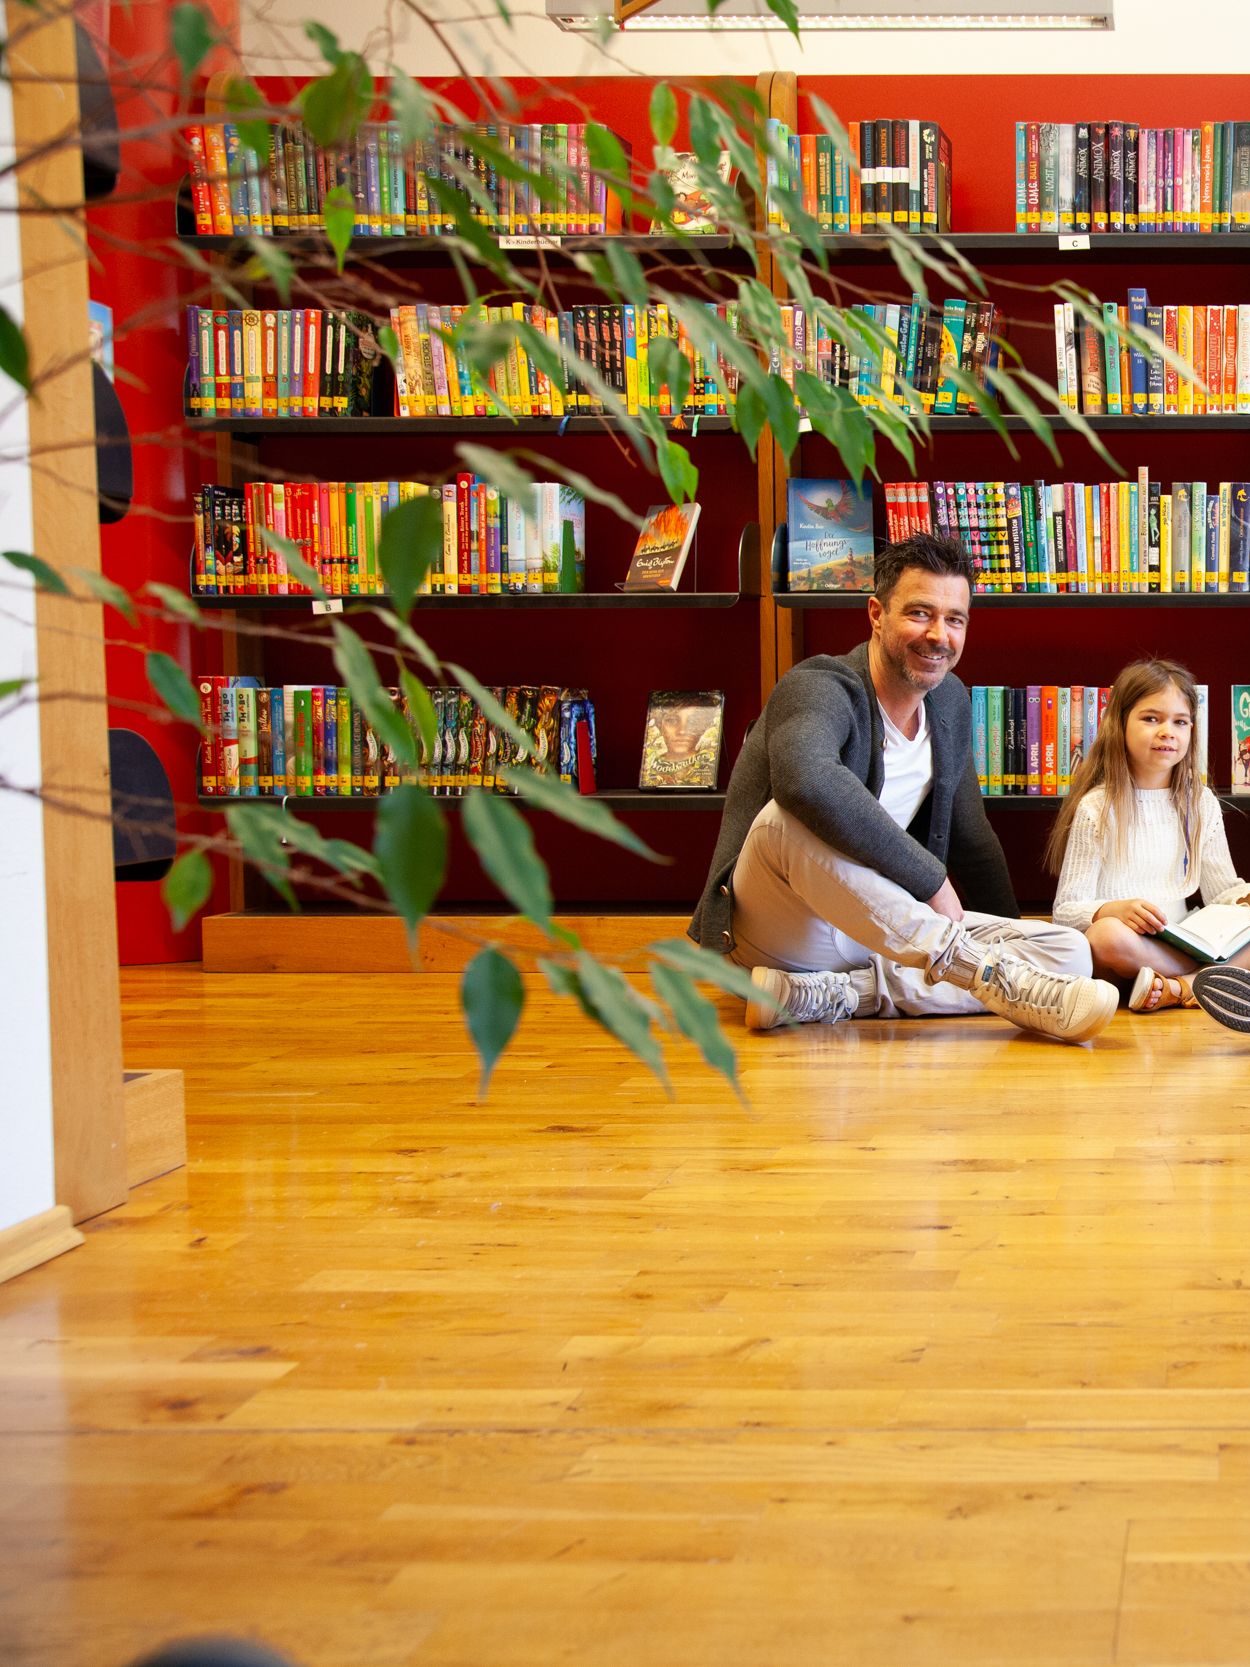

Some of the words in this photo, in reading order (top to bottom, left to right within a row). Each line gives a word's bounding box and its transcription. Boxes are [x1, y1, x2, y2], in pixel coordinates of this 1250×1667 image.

[1078, 147, 1088, 178] ANIMOX
[1092, 142, 1105, 184] ANIMOX
[1111, 149, 1121, 181] ANIMOX
[1127, 150, 1137, 182] ANIMOX
[1201, 163, 1211, 182] mich
[1016, 181, 1026, 204] O.M.G.
[1028, 181, 1039, 204] O.M.G.
[1202, 182, 1211, 203] Nenn
[218, 196, 227, 216] Lola
[1011, 519, 1019, 542] MISSION
[805, 538, 849, 551] Hoffnungs
[818, 548, 839, 560] vogel
[637, 557, 653, 570] Enid
[653, 555, 675, 569] Blyton
[222, 693, 230, 723] THABO
[238, 693, 246, 723] THABO
[1030, 742, 1039, 768] APRIL
[1045, 743, 1054, 768] APRIL
